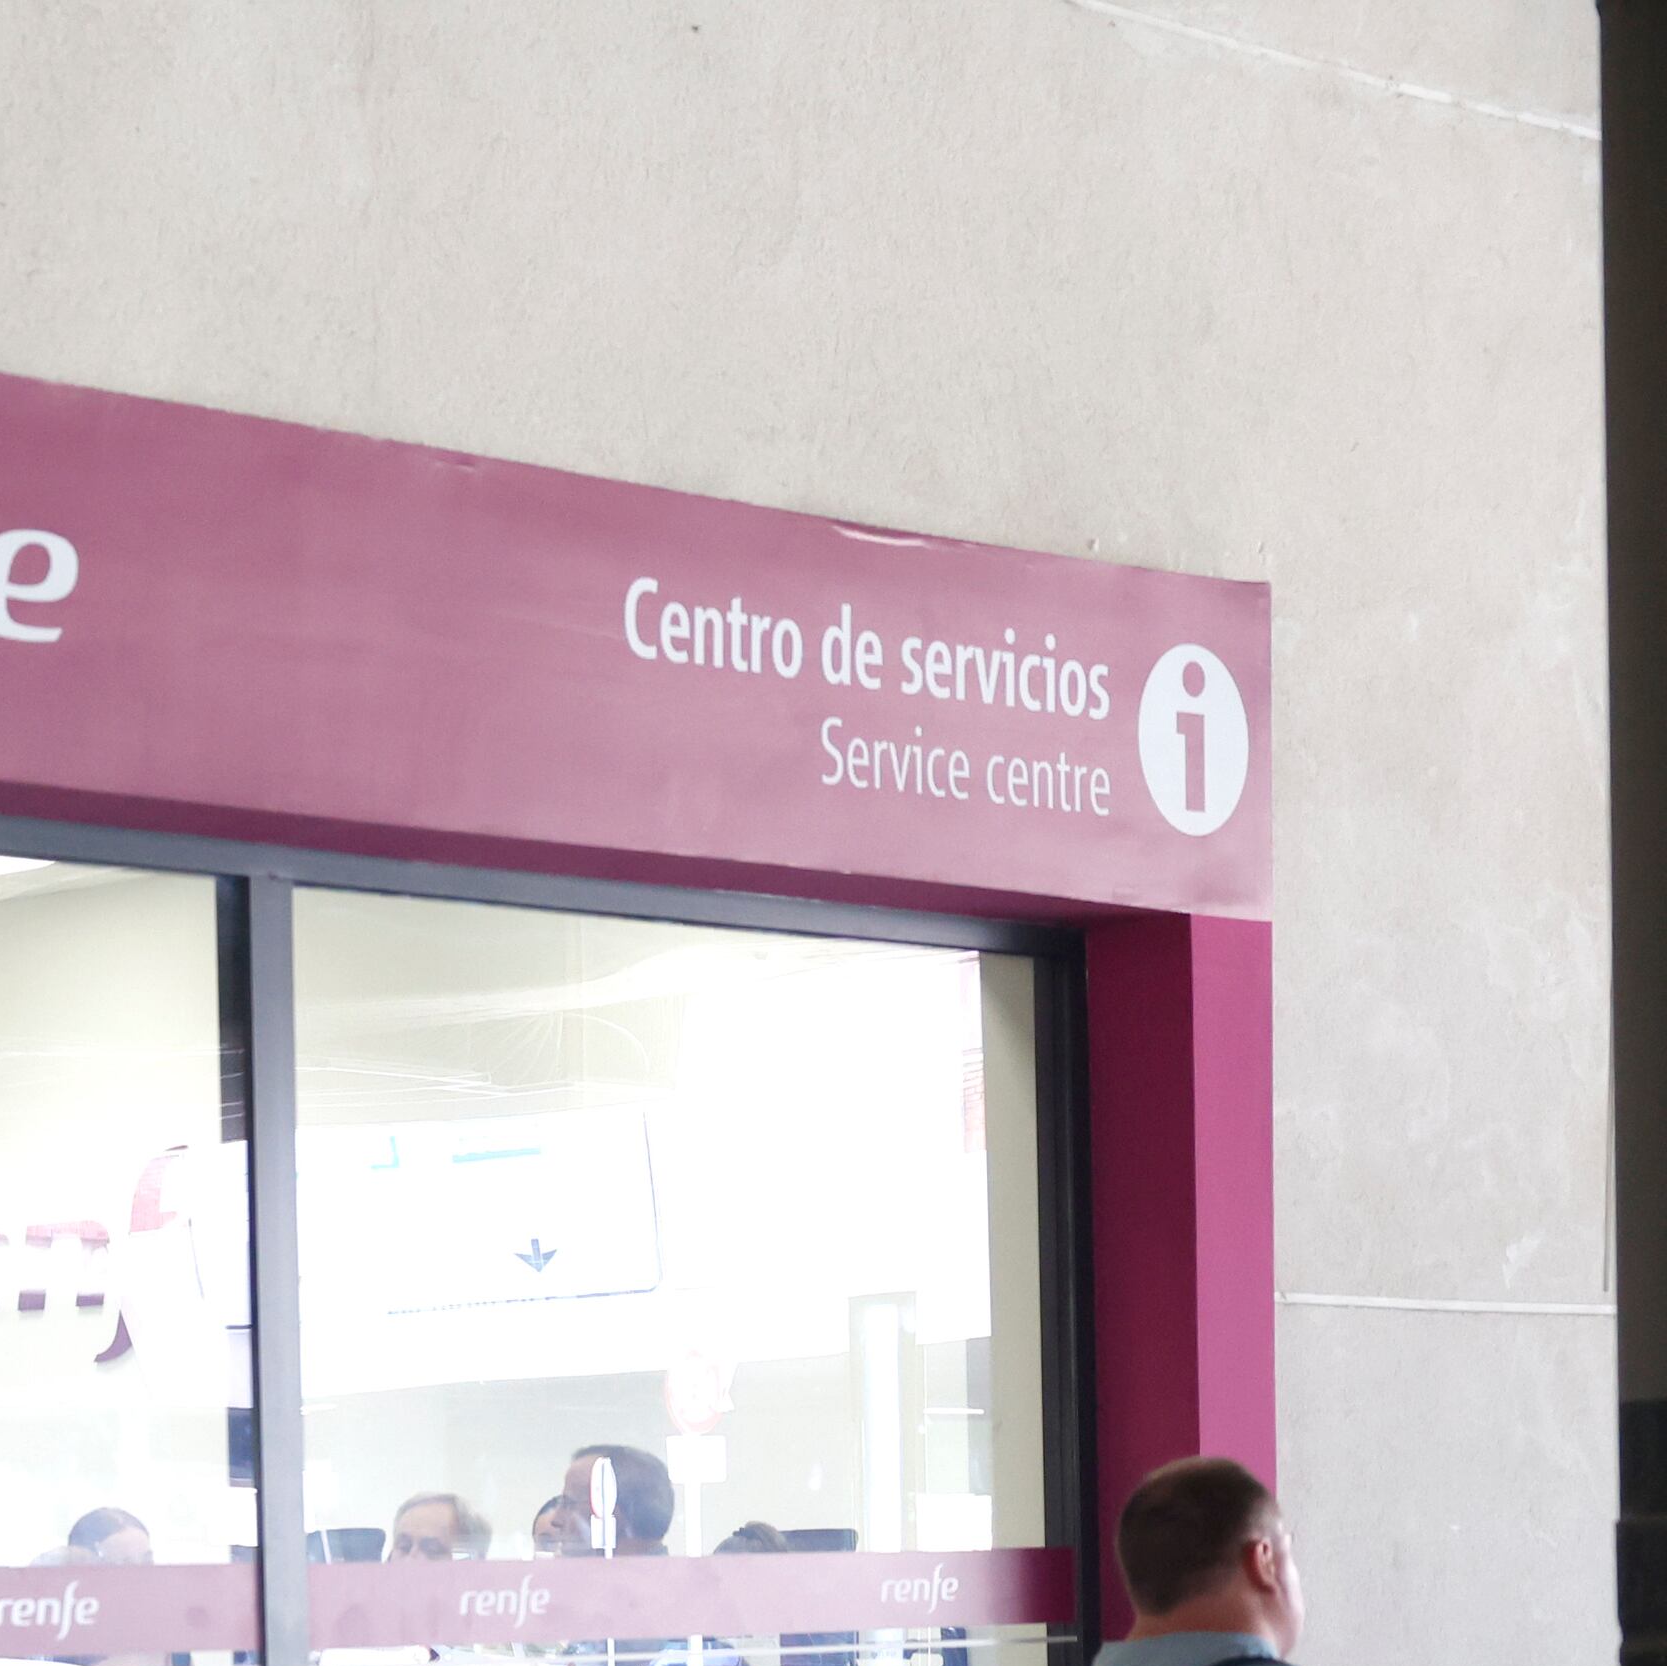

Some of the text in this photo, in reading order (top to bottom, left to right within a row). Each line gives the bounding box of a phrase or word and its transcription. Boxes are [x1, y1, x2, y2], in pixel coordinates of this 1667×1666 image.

[624, 577, 1110, 721] Centro de servicios
[821, 716, 1111, 817] Service centre
[459, 1573, 551, 1629] renfe
[880, 1562, 959, 1614] renfe
